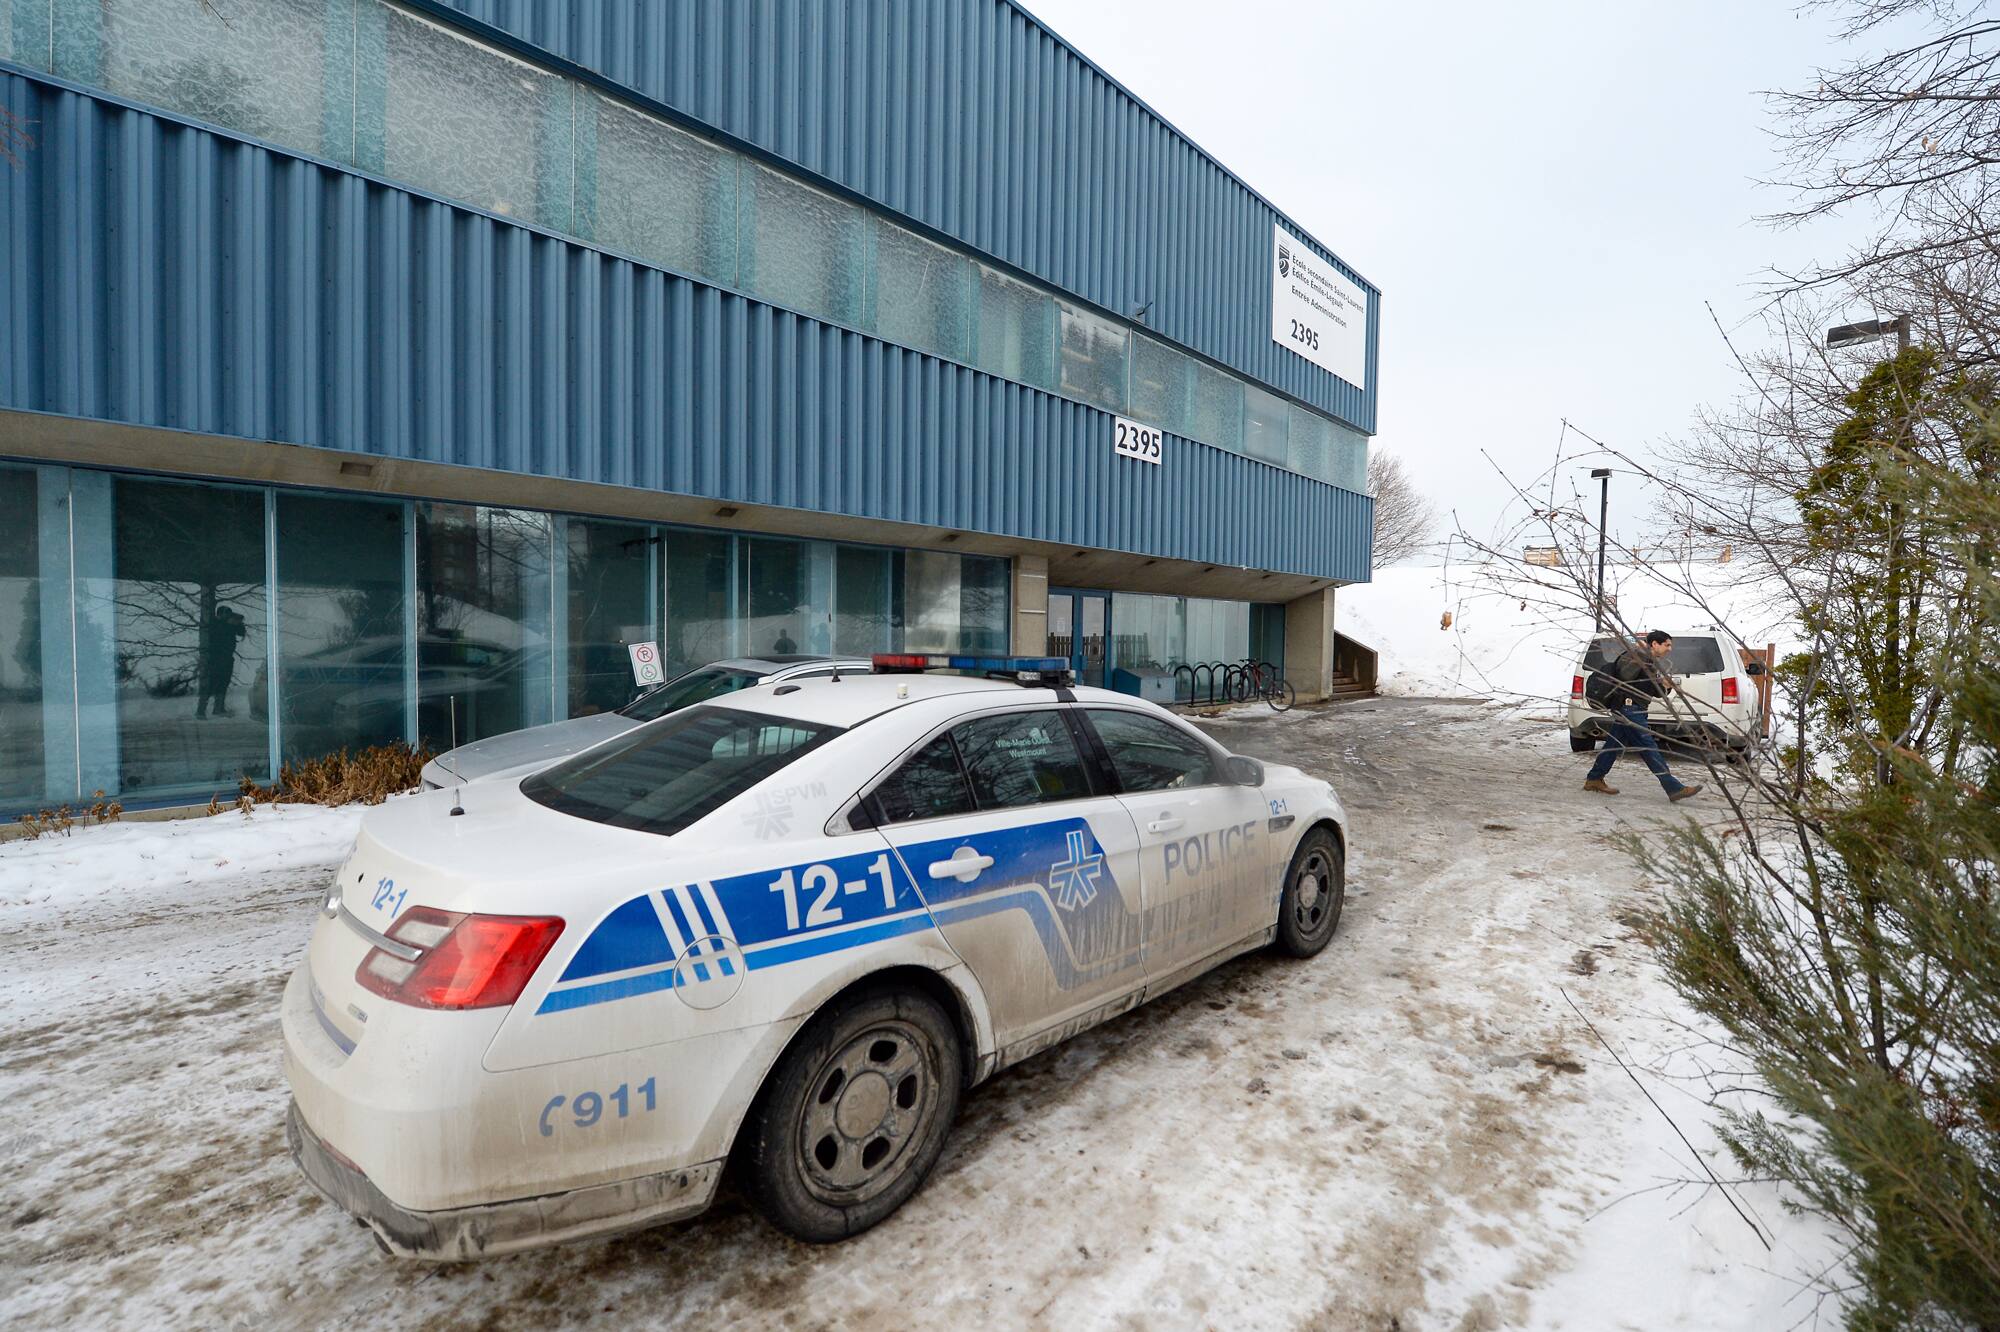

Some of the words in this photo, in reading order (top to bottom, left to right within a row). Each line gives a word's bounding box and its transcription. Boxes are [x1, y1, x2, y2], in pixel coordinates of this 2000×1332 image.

[1292, 266, 1310, 286] Édifice
[1292, 254, 1307, 272] École
[1307, 267, 1334, 291] secondaire
[1334, 285, 1364, 314] Saint-Laurent
[1291, 285, 1310, 306] Entrée
[1310, 299, 1347, 329] Administration
[1291, 318, 1319, 351] 2395
[1117, 423, 1160, 458] 2395
[771, 781, 828, 805] SPVM
[1269, 797, 1288, 816] 12-1
[1163, 820, 1257, 885] POLICE
[371, 876, 408, 919] 12-1
[769, 853, 897, 931] 12-1
[572, 1077, 656, 1128] 911
